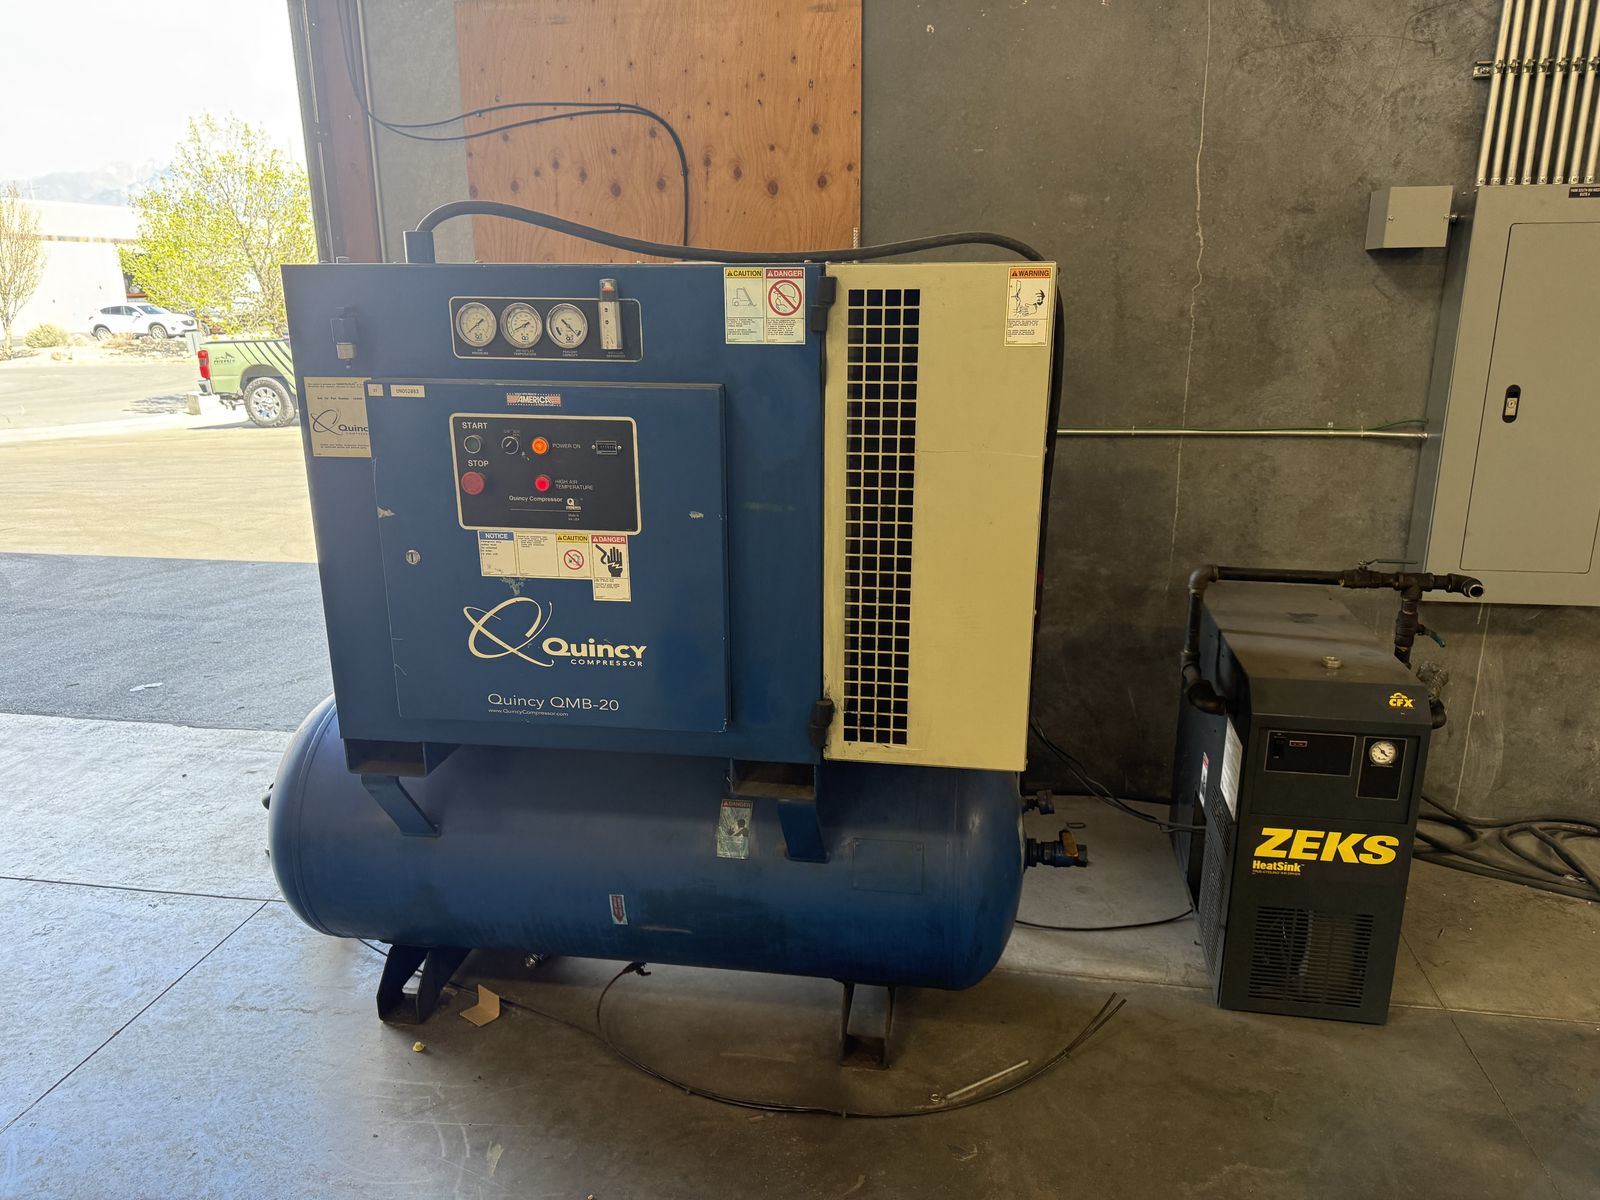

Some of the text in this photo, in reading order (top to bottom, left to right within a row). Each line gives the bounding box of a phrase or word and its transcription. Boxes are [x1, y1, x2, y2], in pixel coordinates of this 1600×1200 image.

[516, 395, 552, 404] AMERICA
[338, 424, 369, 432] Quinc
[529, 495, 563, 503] Compressor
[542, 637, 647, 659] Quincy
[570, 659, 643, 667] COMPRESSOR
[487, 693, 620, 711] Quincy QMB-20
[1388, 698, 1414, 708] CFX
[488, 709, 569, 717] www.QuincyCompressor.com
[1253, 827, 1400, 865] ZEKS
